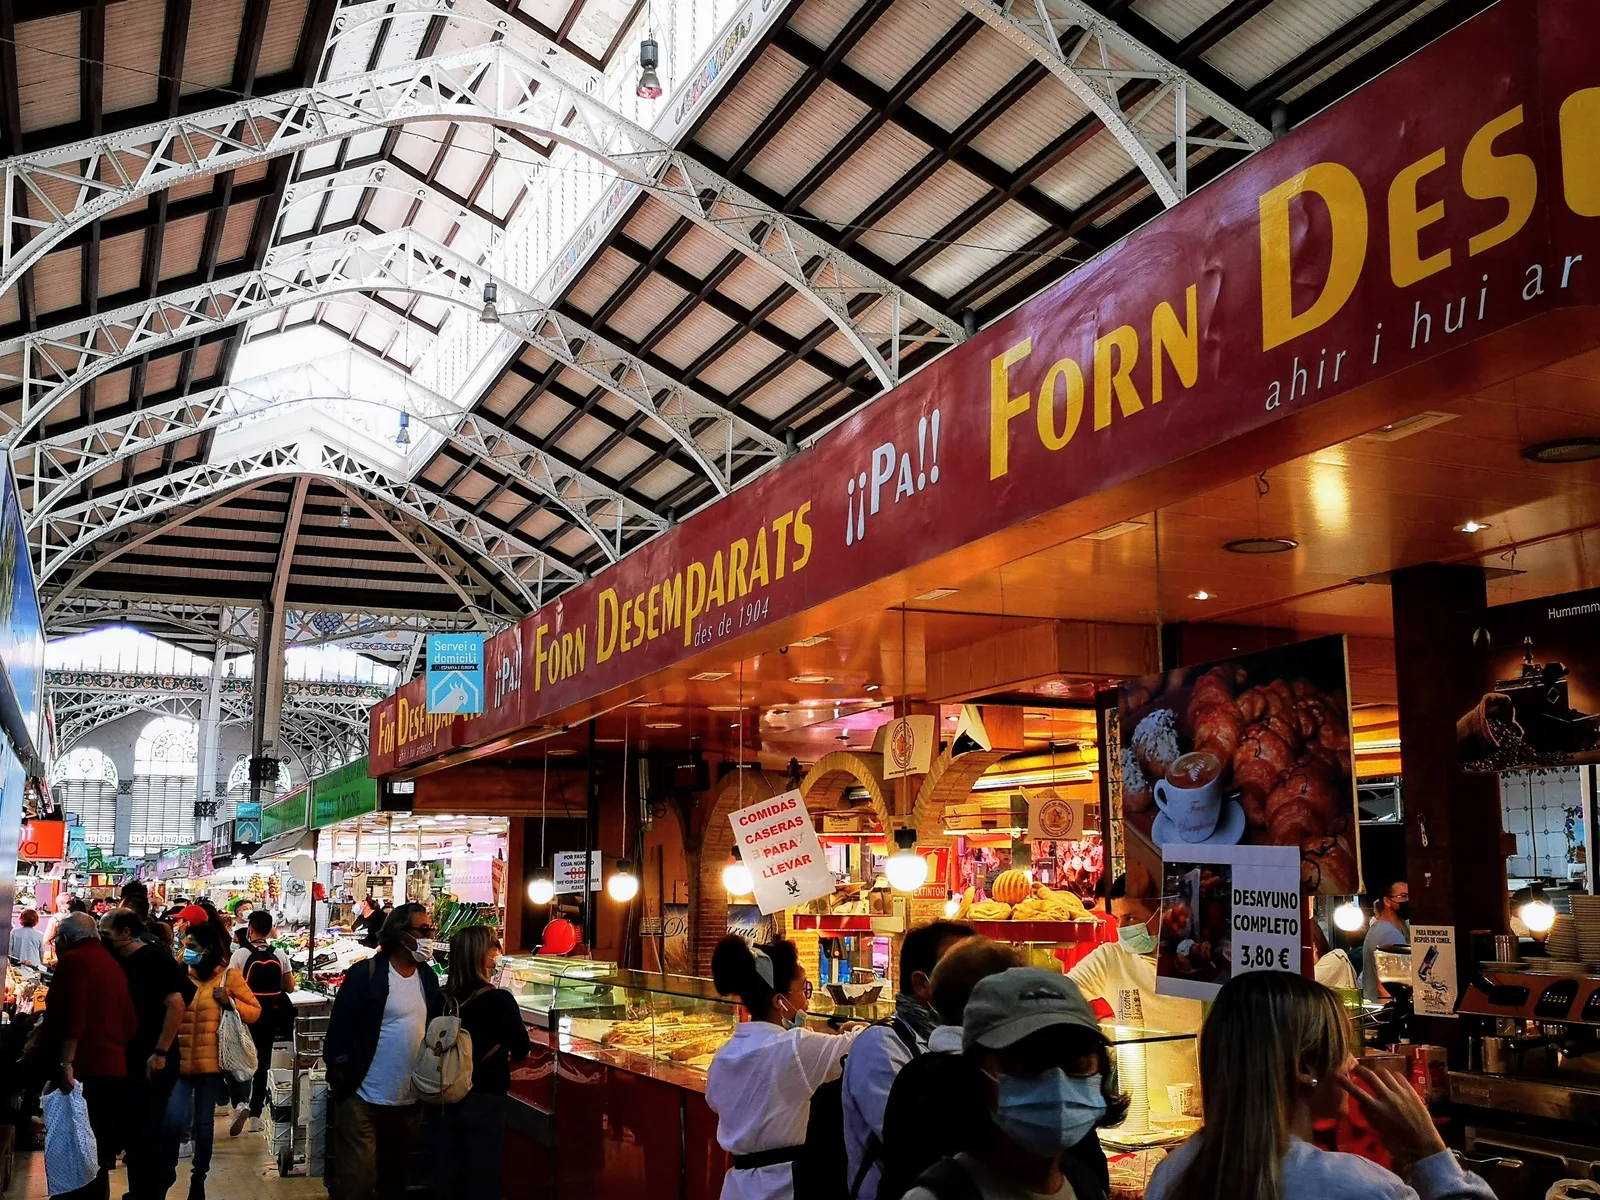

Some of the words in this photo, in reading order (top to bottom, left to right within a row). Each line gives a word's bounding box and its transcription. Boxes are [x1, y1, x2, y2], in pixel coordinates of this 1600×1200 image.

[1265, 348, 1347, 411] ahir
[1371, 322, 1383, 365] i
[1410, 273, 1489, 350] hui
[1521, 254, 1583, 301] ar
[694, 623, 713, 647] des
[718, 612, 732, 637] de
[739, 596, 770, 629] 1904
[434, 640, 467, 651] Servei
[470, 643, 476, 651] a
[434, 652, 477, 663] domicili
[739, 798, 797, 827] COMIDAS
[744, 816, 804, 845] CASERAS
[763, 839, 799, 859] PARA
[762, 854, 813, 879] LLEVAR
[913, 886, 945, 897] EXTINTOR
[1233, 888, 1298, 910] DESAYUNO
[1233, 914, 1298, 936] COMPLETO
[1240, 944, 1274, 968] 3,80
[1277, 947, 1290, 970] €
